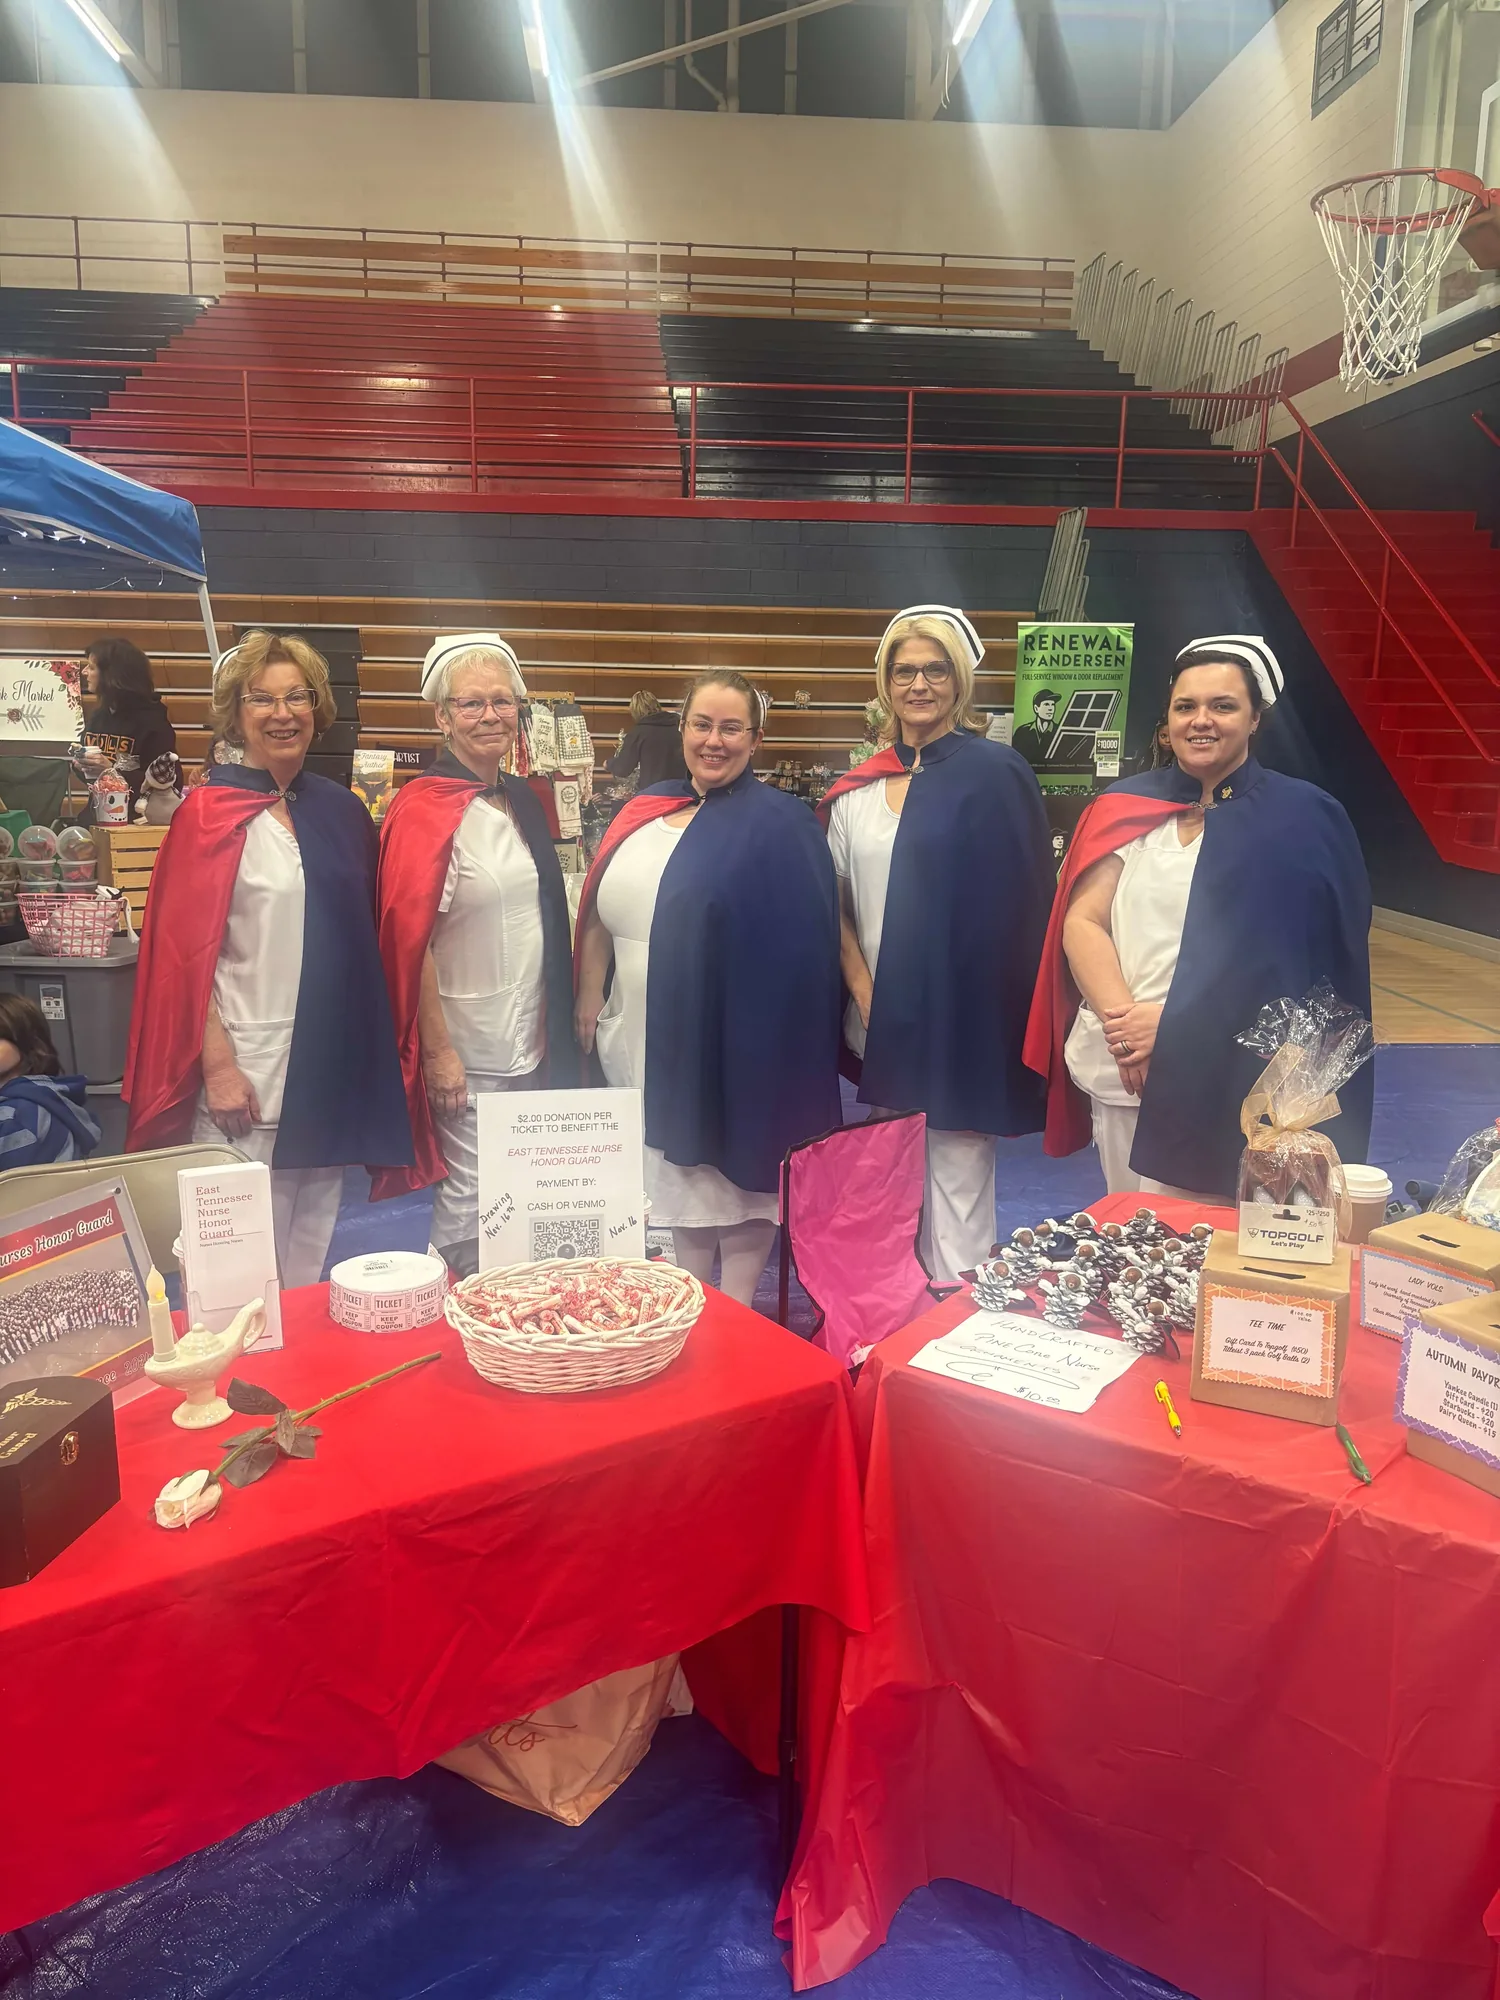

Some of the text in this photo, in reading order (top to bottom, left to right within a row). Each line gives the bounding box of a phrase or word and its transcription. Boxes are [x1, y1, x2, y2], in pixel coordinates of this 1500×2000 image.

[1024, 634, 1126, 651] RENEWAL
[1023, 654, 1126, 667] by ANDERSEN
[1022, 673, 1124, 681] FULL-SERVICE WINDOW & DOOR REPLACEMENT
[12, 680, 55, 703] Market
[360, 752, 388, 762] Fantasy
[517, 1111, 612, 1123] $2.00 DONATION PER
[511, 1122, 619, 1134] TICKET TO BENEFIT THE
[507, 1144, 623, 1156] EAST TENNESSEE NURSE
[530, 1156, 601, 1167] HONOR GUARD
[536, 1178, 597, 1188] PAYMENT BY:
[195, 1185, 220, 1196] East
[196, 1193, 253, 1207] Tennessee
[527, 1199, 606, 1211] CASH OR VENMO
[197, 1207, 230, 1218] Nurse
[479, 1192, 513, 1225] Drawing
[198, 1218, 233, 1229] Honor
[484, 1205, 516, 1240] Nov. 16th
[608, 1215, 638, 1239] Nov. 16
[0, 1208, 114, 1267] urses Honor Guard
[199, 1227, 234, 1240] Guard
[1260, 1229, 1325, 1243] TOPGOLF
[1288, 1242, 1305, 1250] Play
[1368, 1279, 1379, 1289] Lady
[1399, 1288, 1411, 1297] hand
[1407, 1276, 1444, 1293] LADY VOLS
[343, 1292, 362, 1306] TICKET
[376, 1298, 402, 1309] TICKET
[416, 1288, 437, 1303] TICKET
[1383, 1291, 1429, 1309] University of Tennessee
[420, 1306, 435, 1316] KEEP
[341, 1317, 363, 1328] COUPON
[416, 1313, 438, 1324] COUPON
[1249, 1319, 1287, 1332] TEE TIME
[1225, 1337, 1309, 1355] Gift Card To Topgolf ($50)
[1248, 1349, 1266, 1358] pack
[1267, 1351, 1281, 1362] Golf
[1282, 1353, 1300, 1363] Balls
[1300, 1356, 1310, 1365] (2)
[1426, 1347, 1467, 1373] AUTUMN
[1444, 1380, 1467, 1397] Yankee
[1468, 1391, 1490, 1407] Candle
[1445, 1390, 1459, 1402] Gift
[1459, 1397, 1475, 1410] Card
[1481, 1407, 1494, 1419] $20
[1442, 1398, 1476, 1420] Starbucks
[1481, 1416, 1495, 1429] $20
[1439, 1405, 1457, 1421] Dairy
[1457, 1414, 1478, 1430] Queen
[1483, 1426, 1497, 1439] $15
